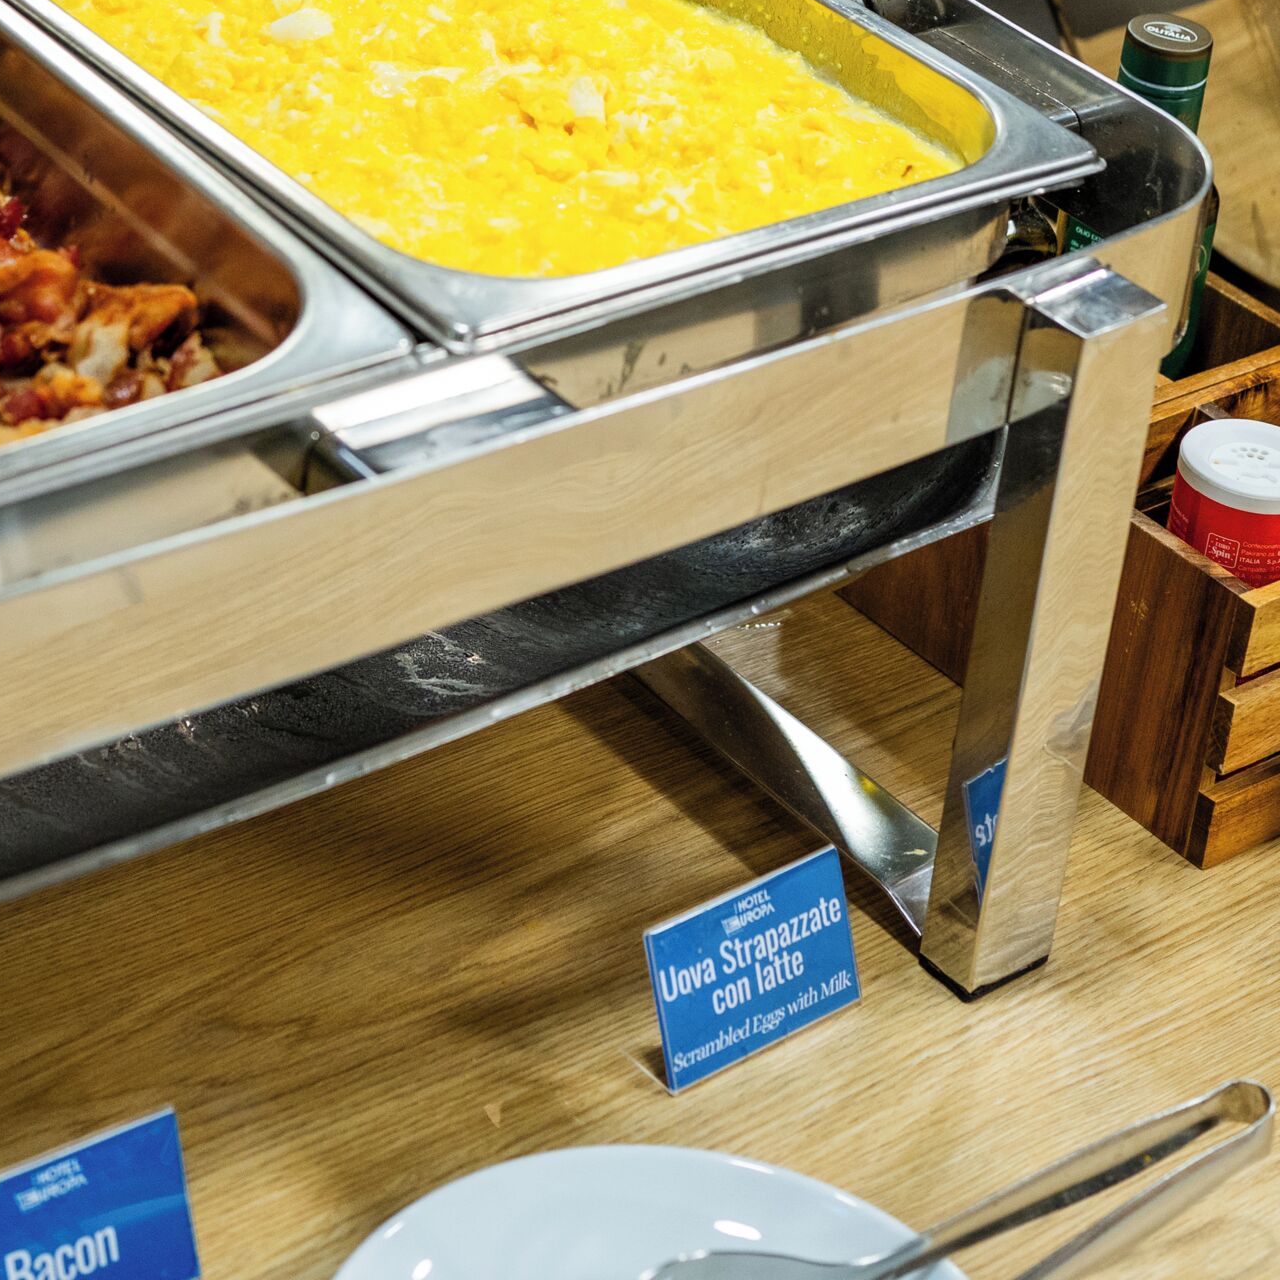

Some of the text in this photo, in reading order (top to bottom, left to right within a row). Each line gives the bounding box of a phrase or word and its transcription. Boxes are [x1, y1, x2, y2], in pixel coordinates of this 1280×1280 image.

[1146, 25, 1191, 41] OLITALIA
[1212, 546, 1231, 559] Spin
[738, 888, 771, 913] HOTEL
[659, 896, 842, 1003] Uova Strapazzate
[712, 950, 805, 1015] con latte
[673, 970, 852, 1073] Scrambled Eggs with Milk
[4, 1225, 119, 1280] Bacon
